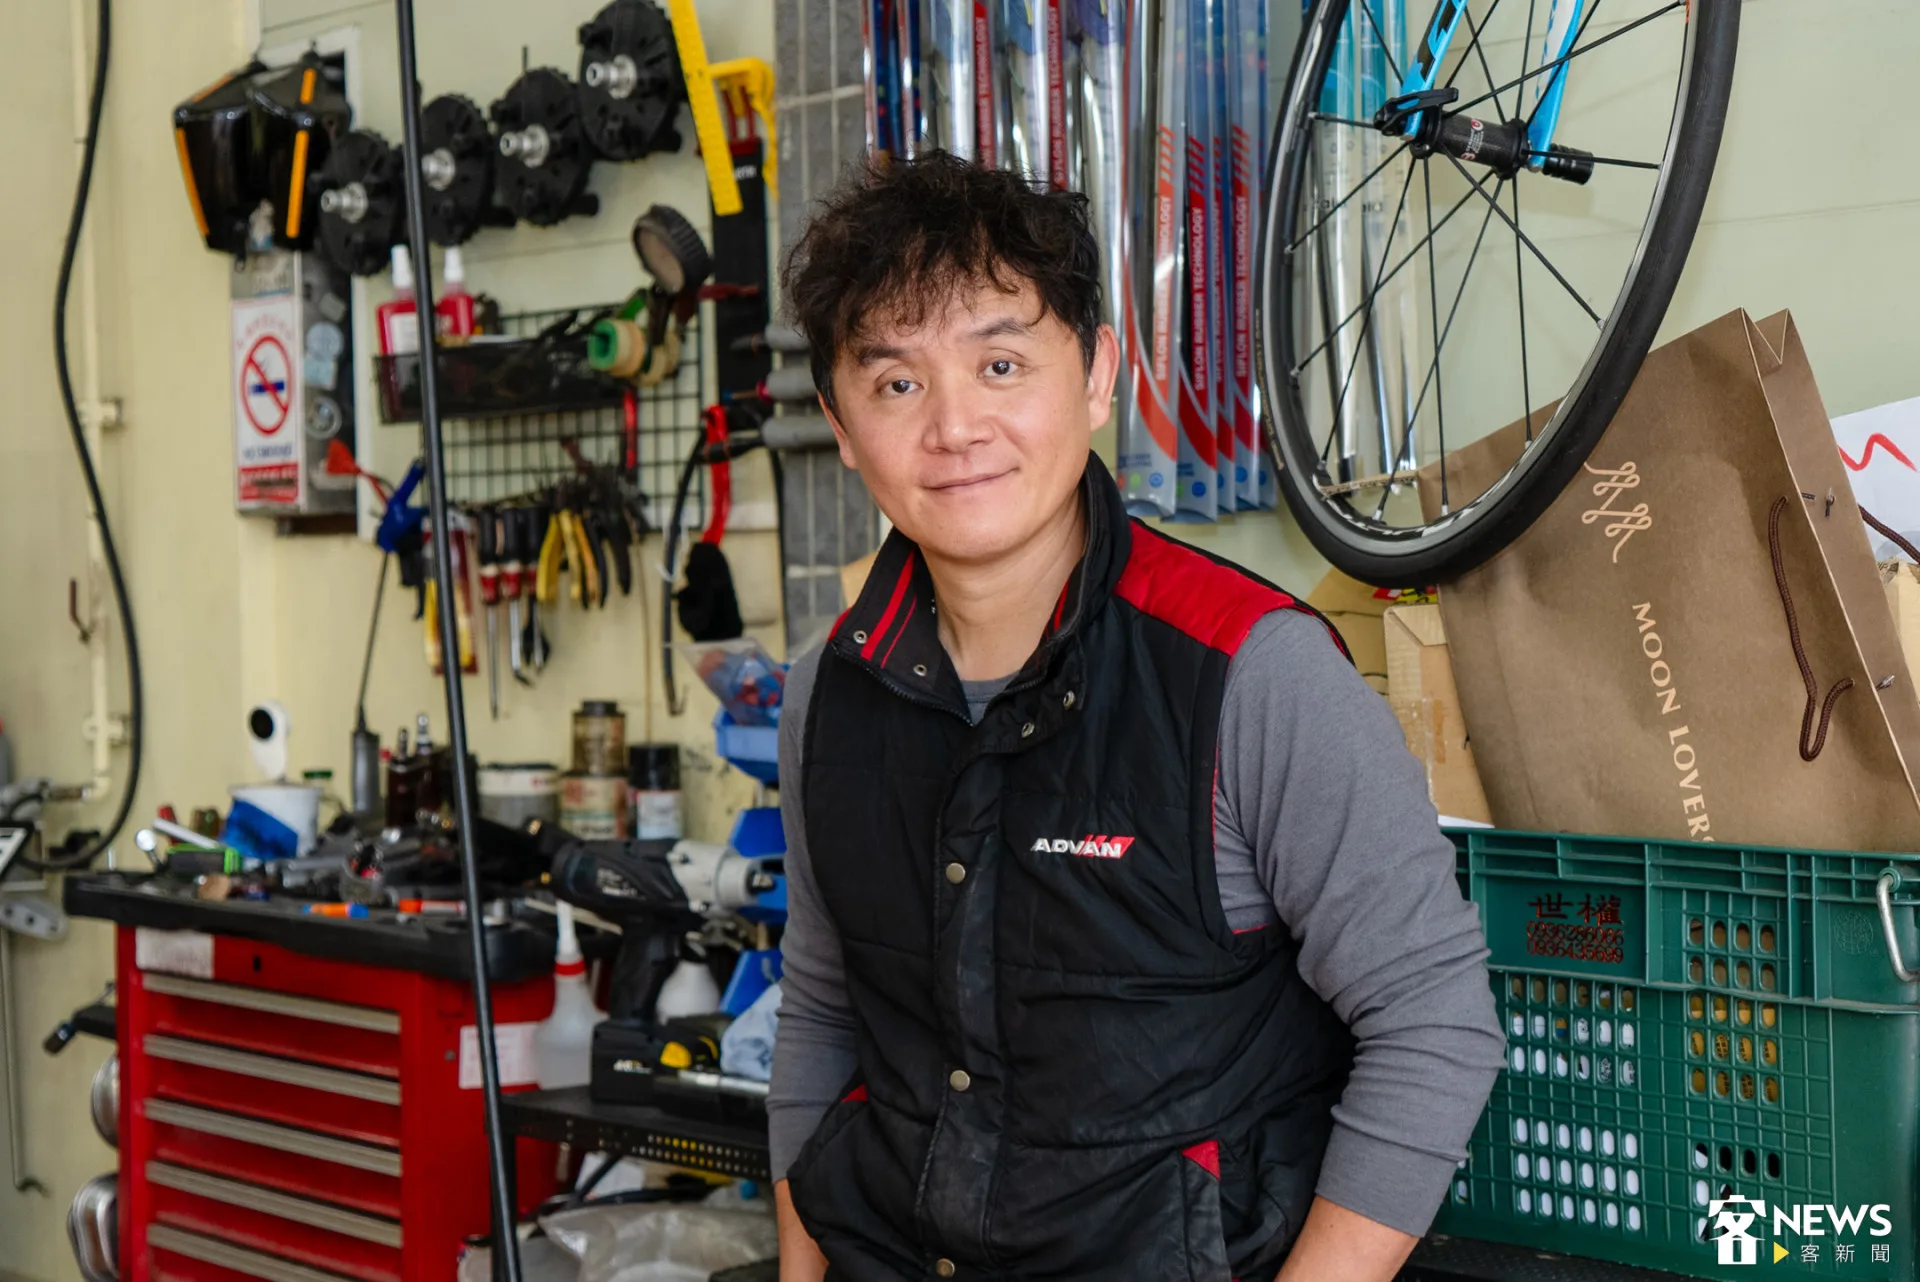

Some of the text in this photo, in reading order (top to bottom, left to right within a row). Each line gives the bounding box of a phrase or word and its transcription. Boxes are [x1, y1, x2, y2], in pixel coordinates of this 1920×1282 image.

[1192, 207, 1204, 290] TECHNOLOGY
[1632, 602, 1681, 715] MOON
[1030, 837, 1123, 858] ADVAN
